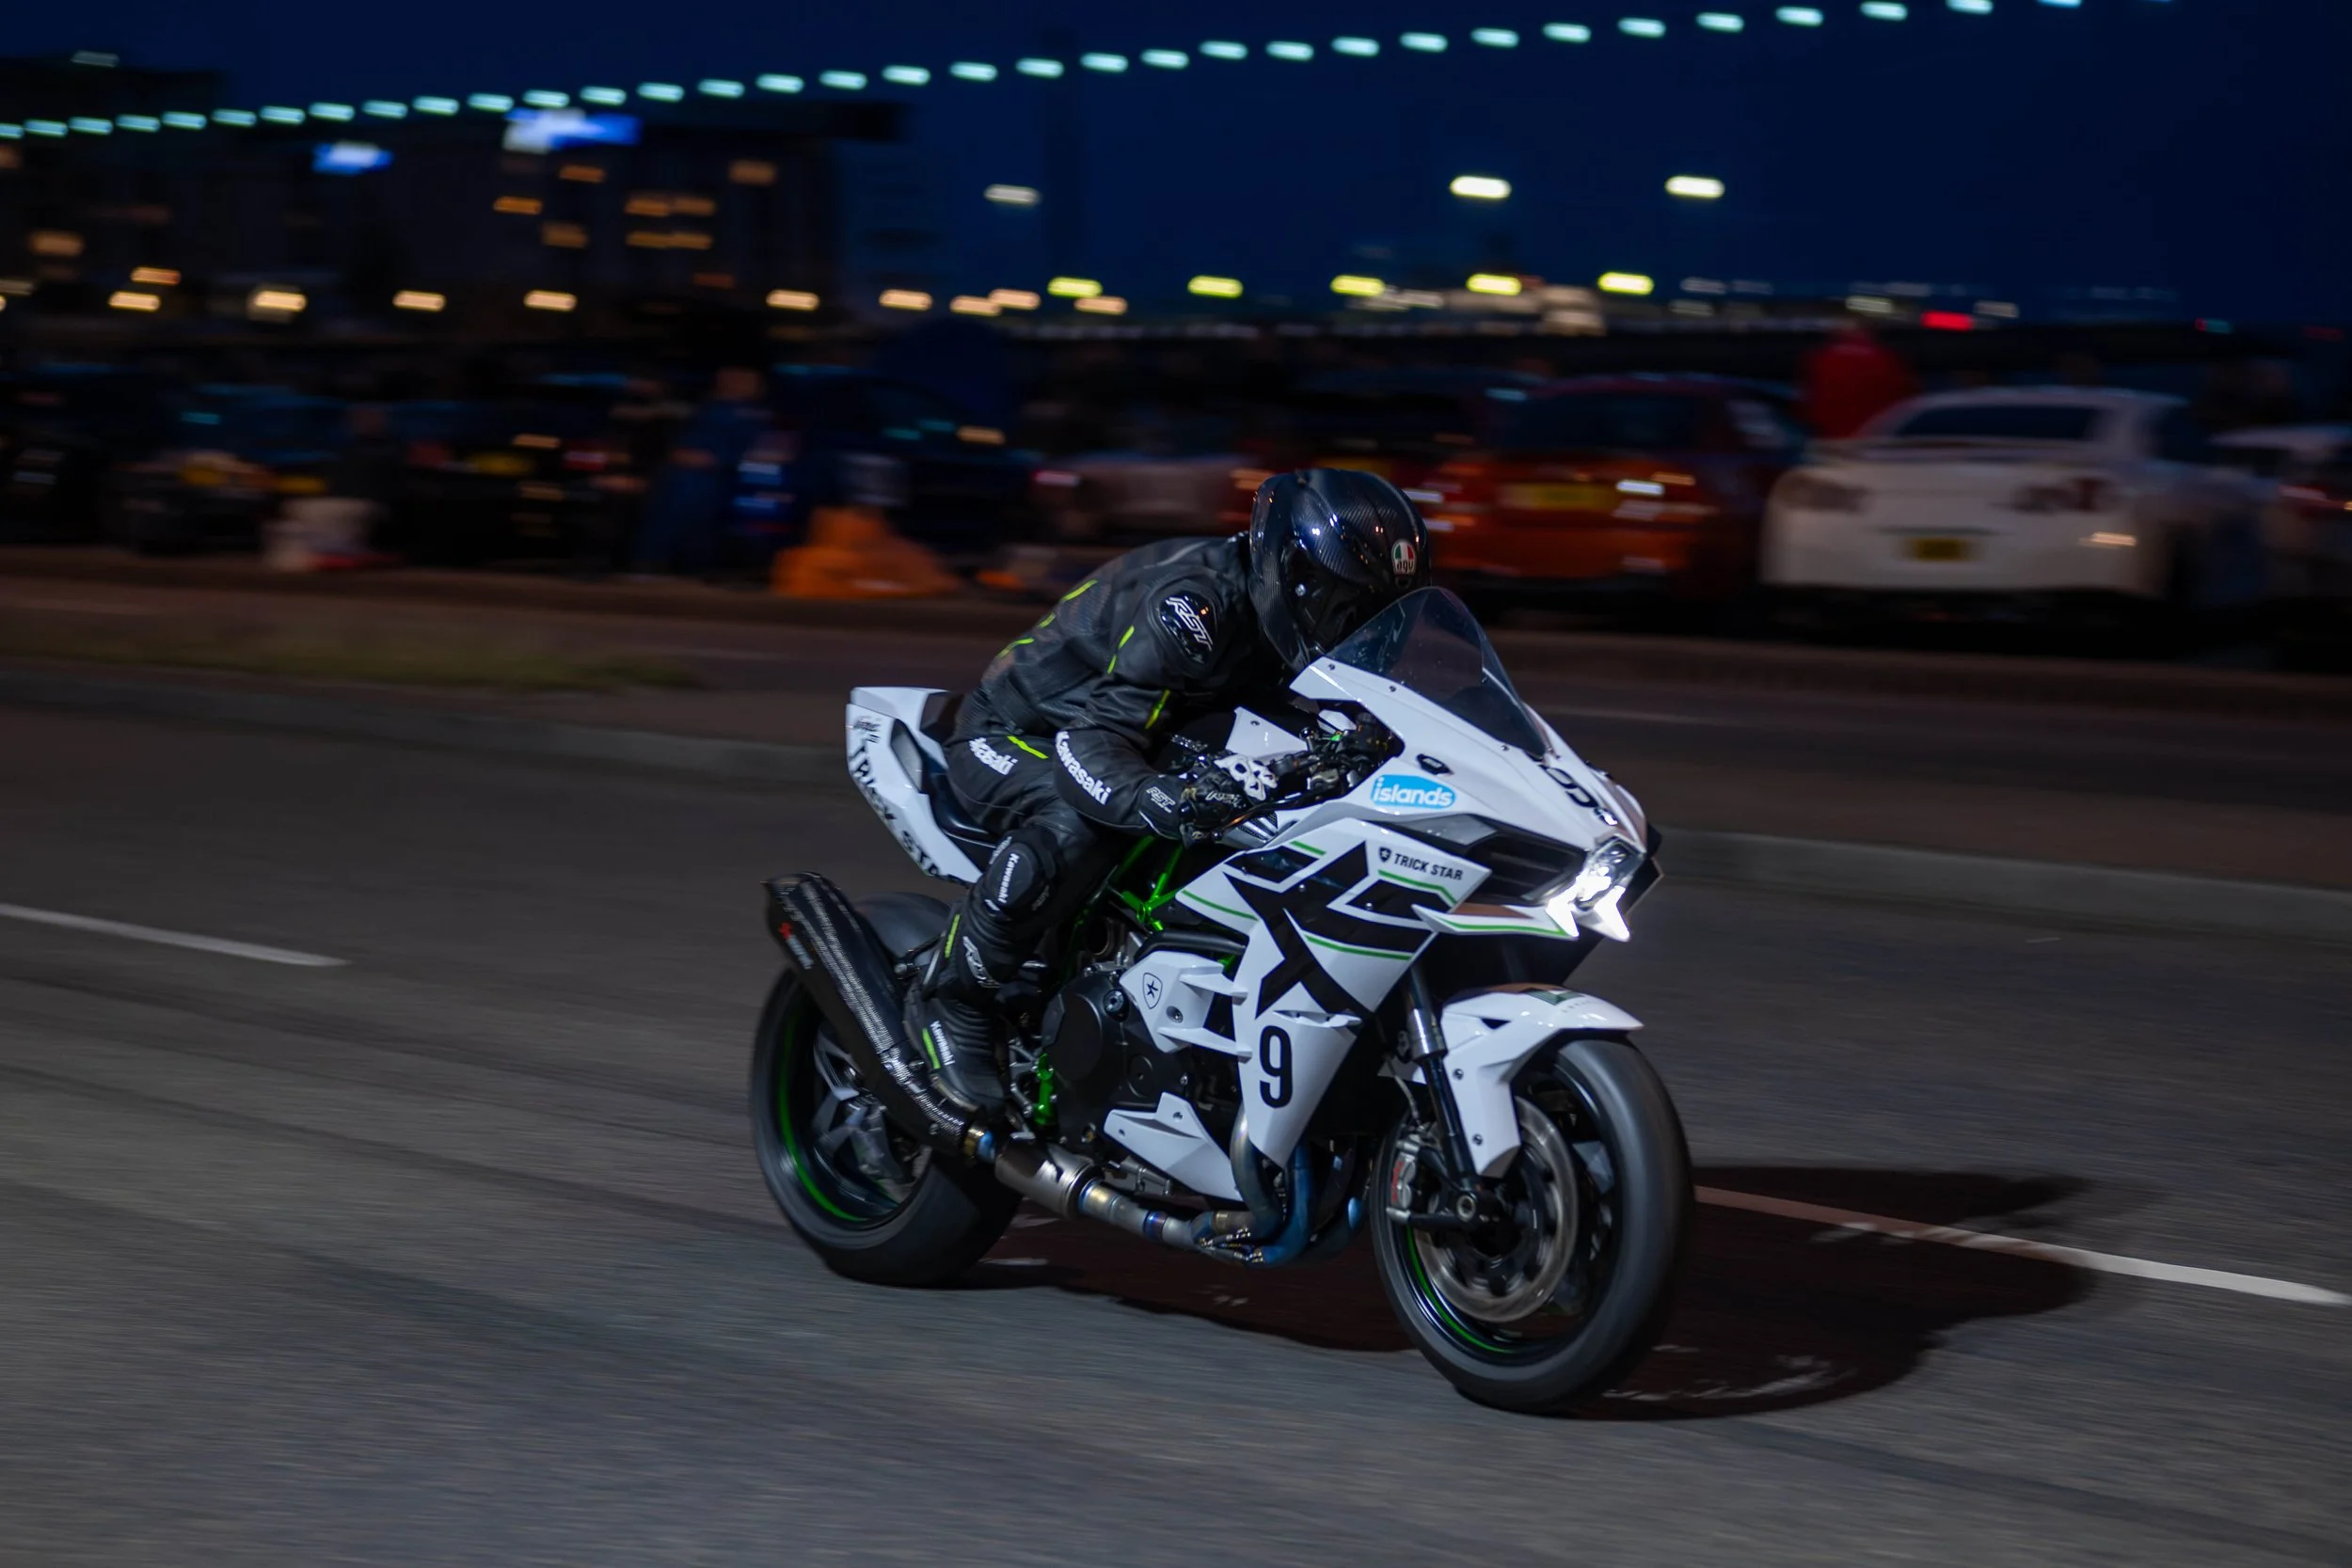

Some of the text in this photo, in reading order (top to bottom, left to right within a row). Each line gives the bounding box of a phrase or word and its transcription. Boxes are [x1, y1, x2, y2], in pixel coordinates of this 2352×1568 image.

[1165, 595, 1214, 652] RST
[1055, 731, 1112, 805] Kawasaki
[1373, 777, 1454, 807] islands
[1146, 786, 1176, 807] RST
[998, 853, 1020, 904] Kawasaki
[1394, 853, 1464, 880] TRICK STAR
[1260, 1025, 1293, 1108] 9
